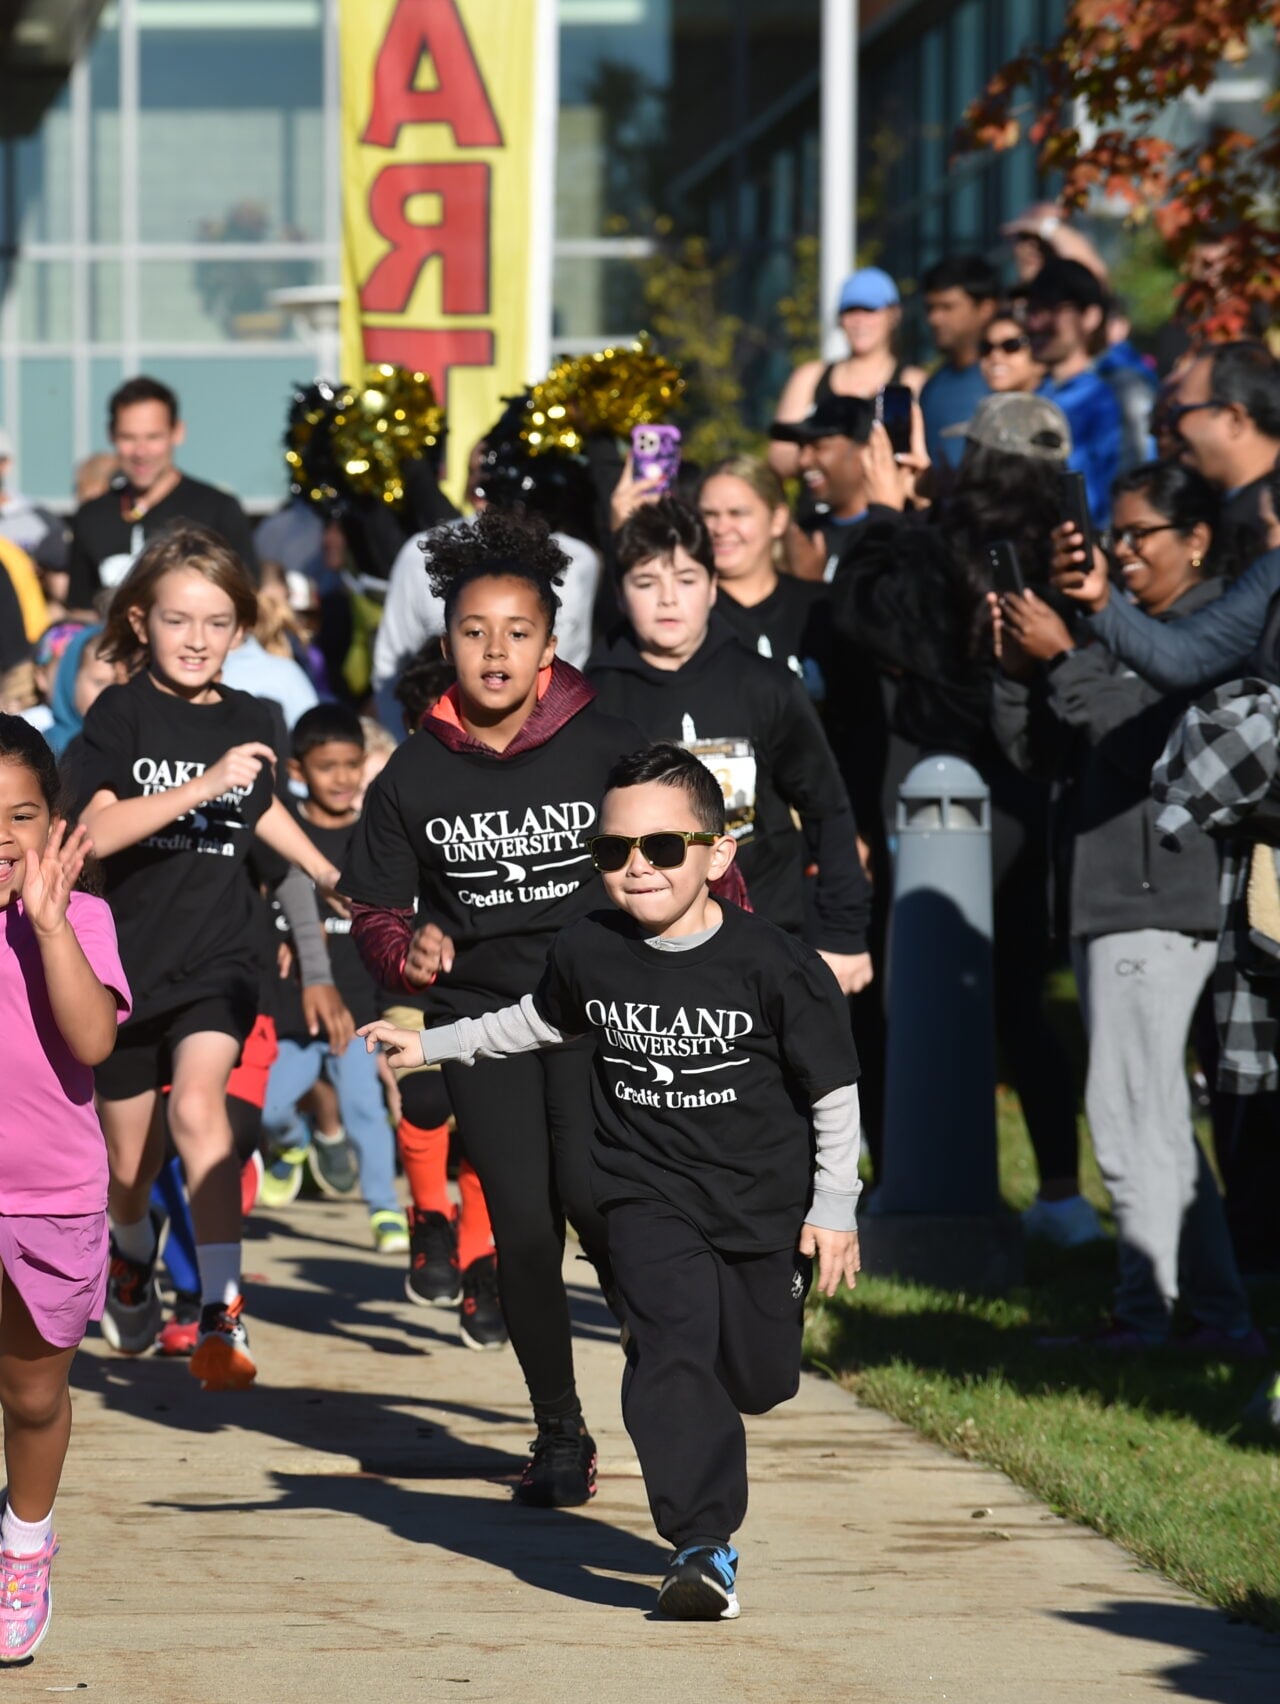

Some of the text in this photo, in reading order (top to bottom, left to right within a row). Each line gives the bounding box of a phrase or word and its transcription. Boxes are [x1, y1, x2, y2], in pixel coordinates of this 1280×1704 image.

[425, 801, 596, 844] OAKLAND
[458, 880, 580, 908] Credit Union
[585, 999, 753, 1040] OAKLAND
[615, 1080, 737, 1109] Credit Union
